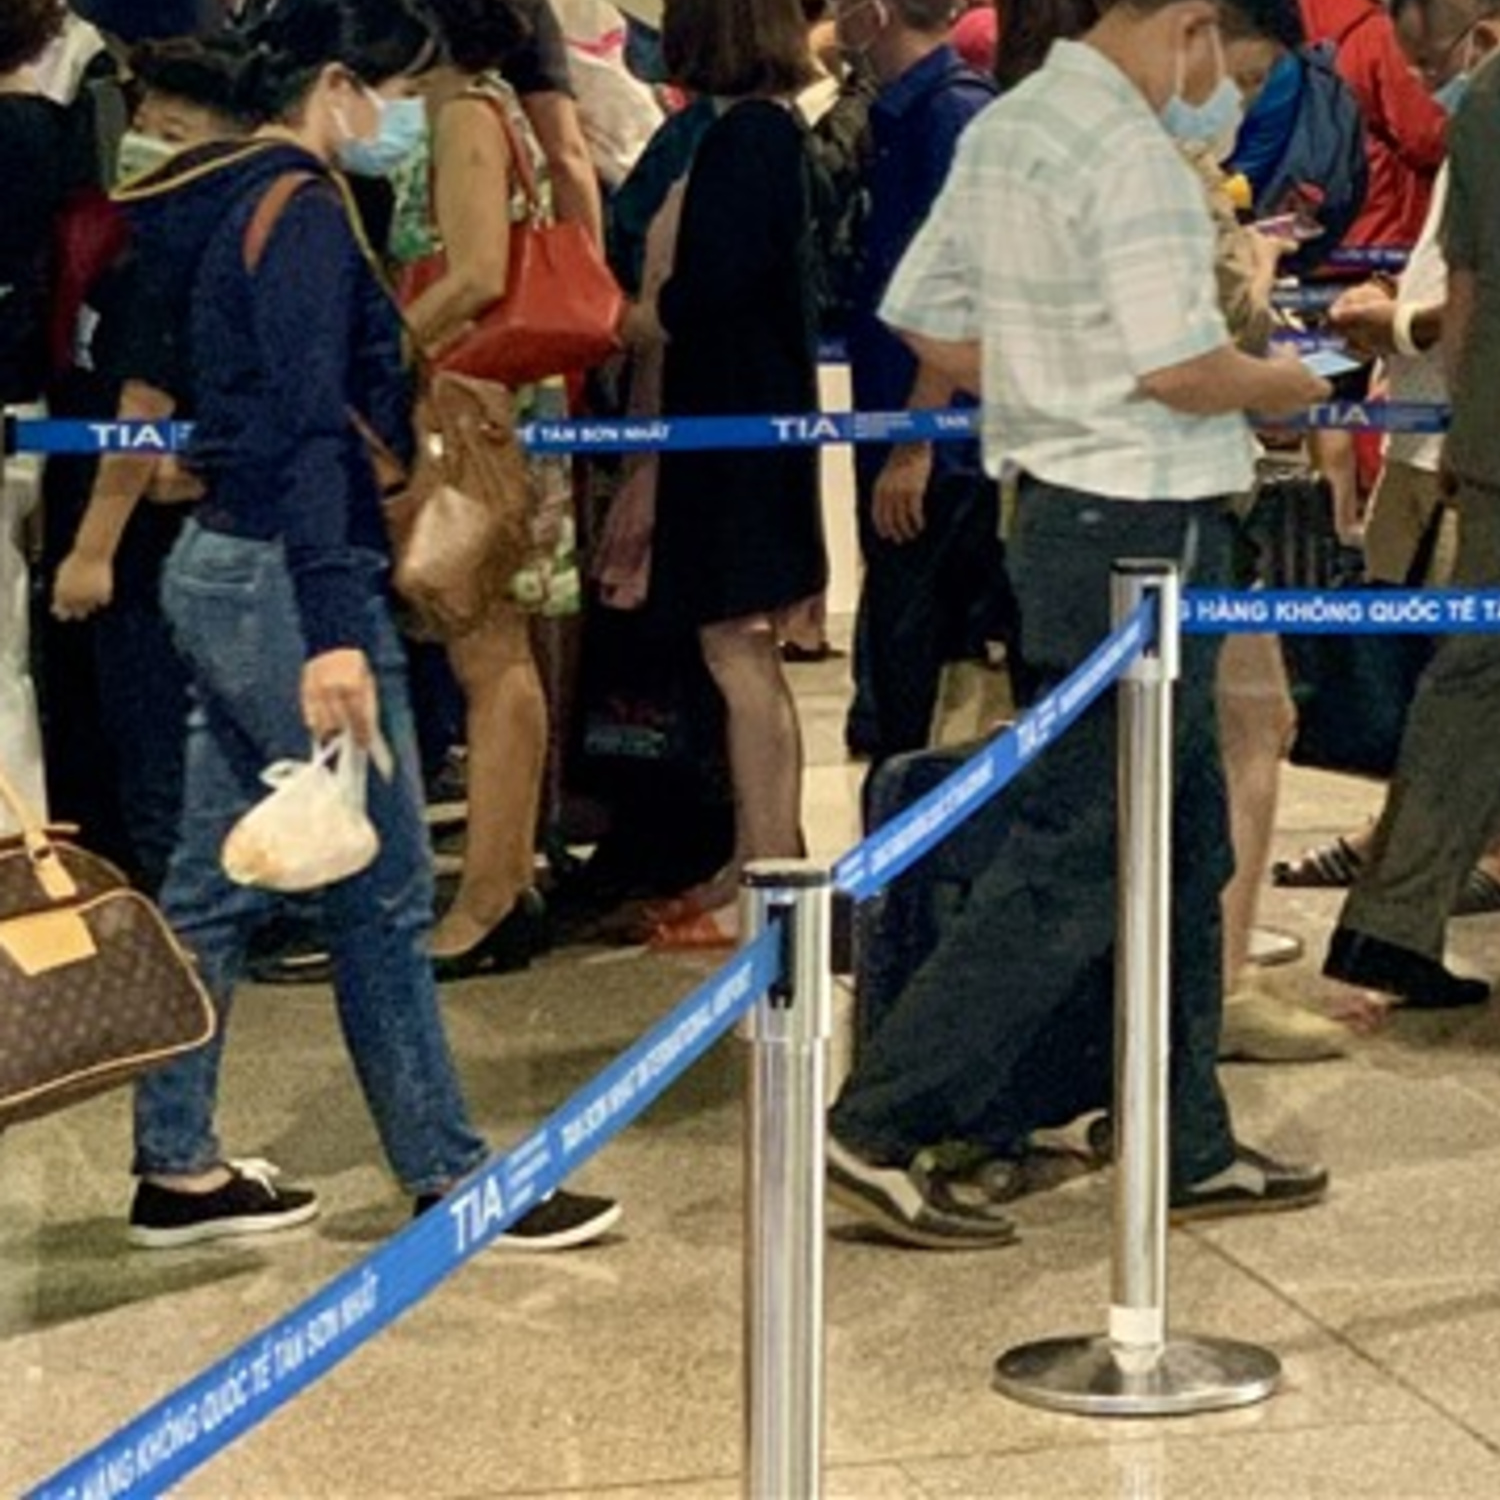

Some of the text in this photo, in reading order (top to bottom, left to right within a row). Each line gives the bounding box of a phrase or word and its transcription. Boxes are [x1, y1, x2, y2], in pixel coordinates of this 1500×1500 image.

[88, 423, 165, 448] TIA
[770, 416, 840, 440] TIA
[1196, 595, 1268, 622] HÀNG
[1275, 595, 1363, 622] KHÔNG
[1368, 591, 1441, 622] QUỐC
[1447, 594, 1477, 622] TẾ
[450, 1174, 505, 1253] TIA
